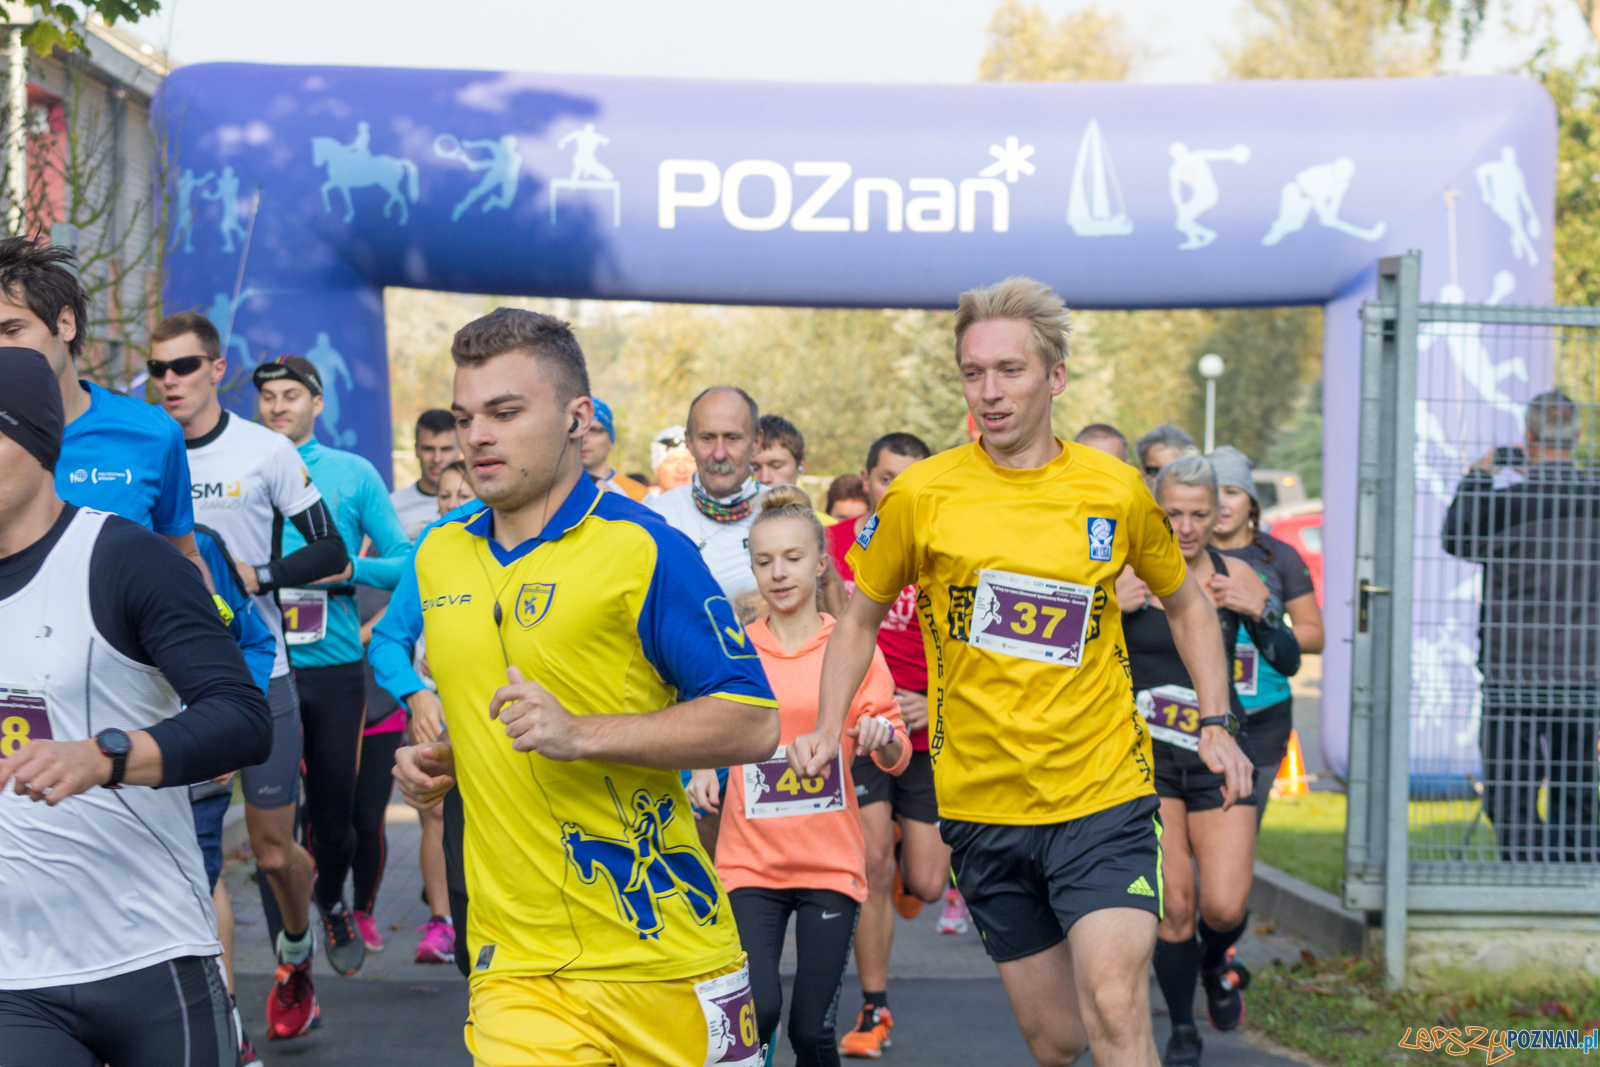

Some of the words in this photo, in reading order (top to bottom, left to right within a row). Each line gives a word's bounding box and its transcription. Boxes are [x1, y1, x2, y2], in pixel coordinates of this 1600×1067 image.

[1010, 601, 1067, 639] 37
[1163, 704, 1199, 732] 13
[776, 767, 824, 795] 46
